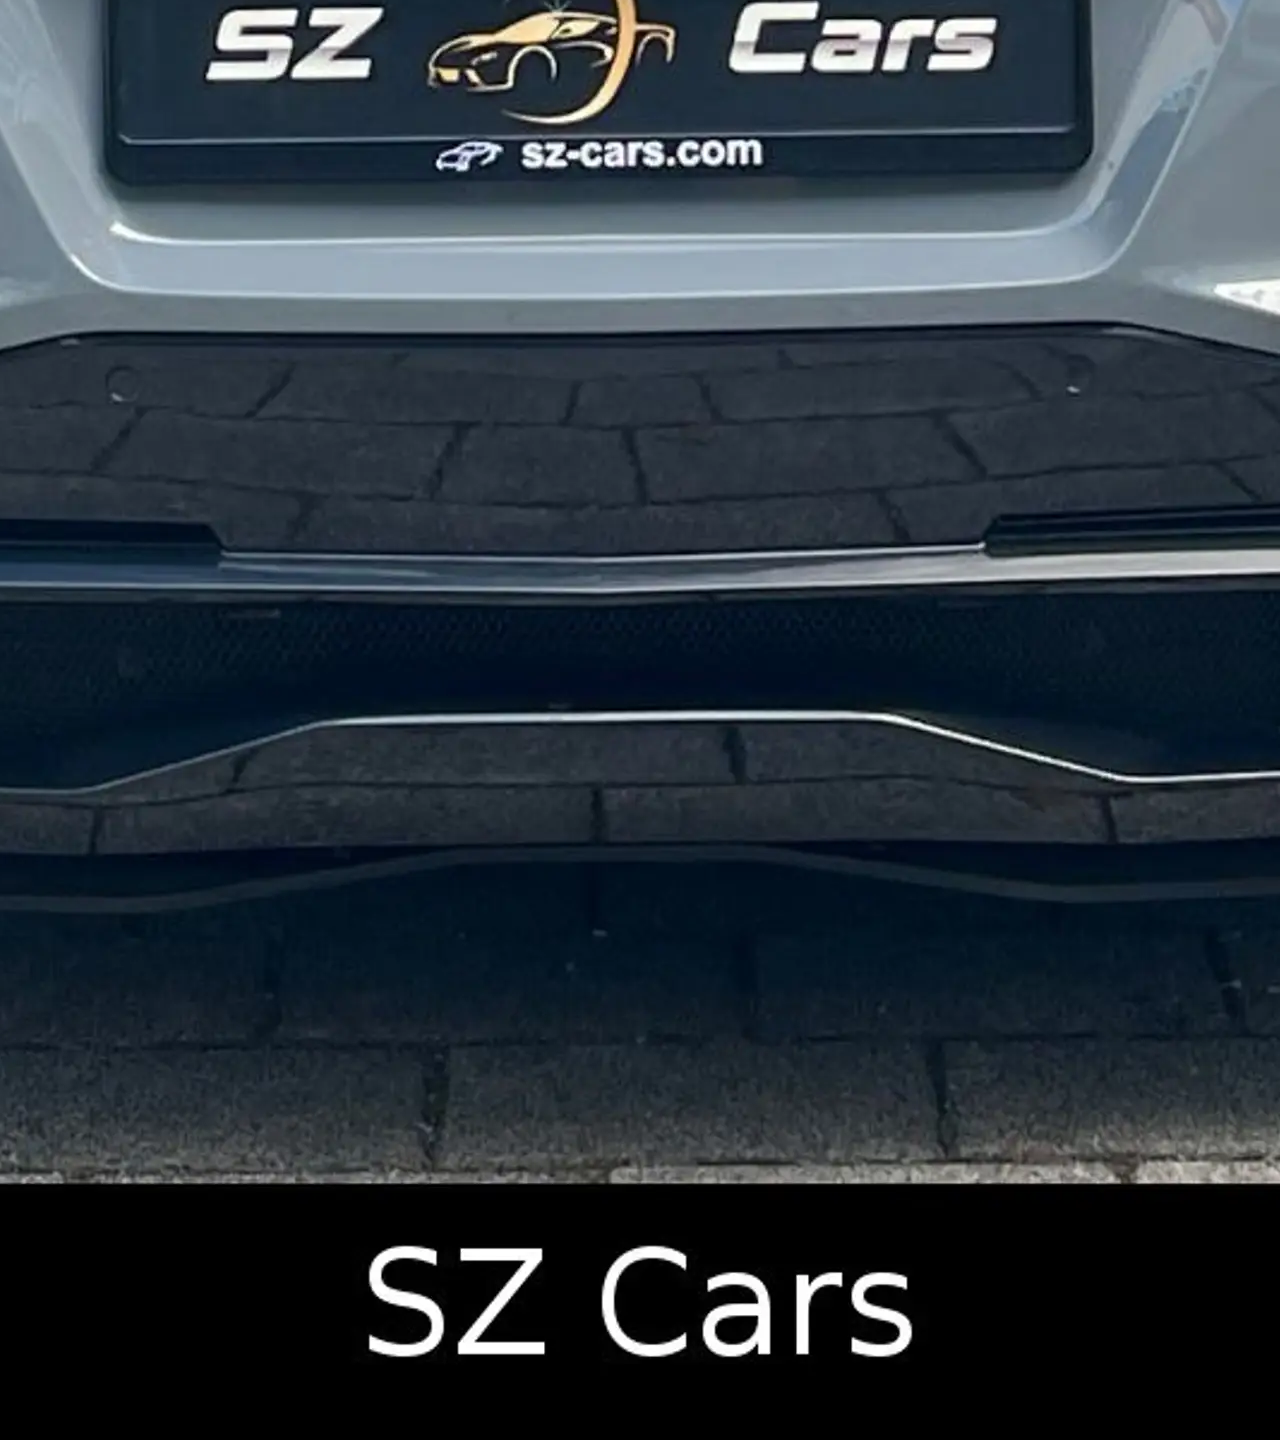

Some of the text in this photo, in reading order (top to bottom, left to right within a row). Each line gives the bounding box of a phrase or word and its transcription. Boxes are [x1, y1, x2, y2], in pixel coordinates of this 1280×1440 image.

[204, 0, 998, 82] SZ Cars
[520, 137, 764, 171] sz-cars.com
